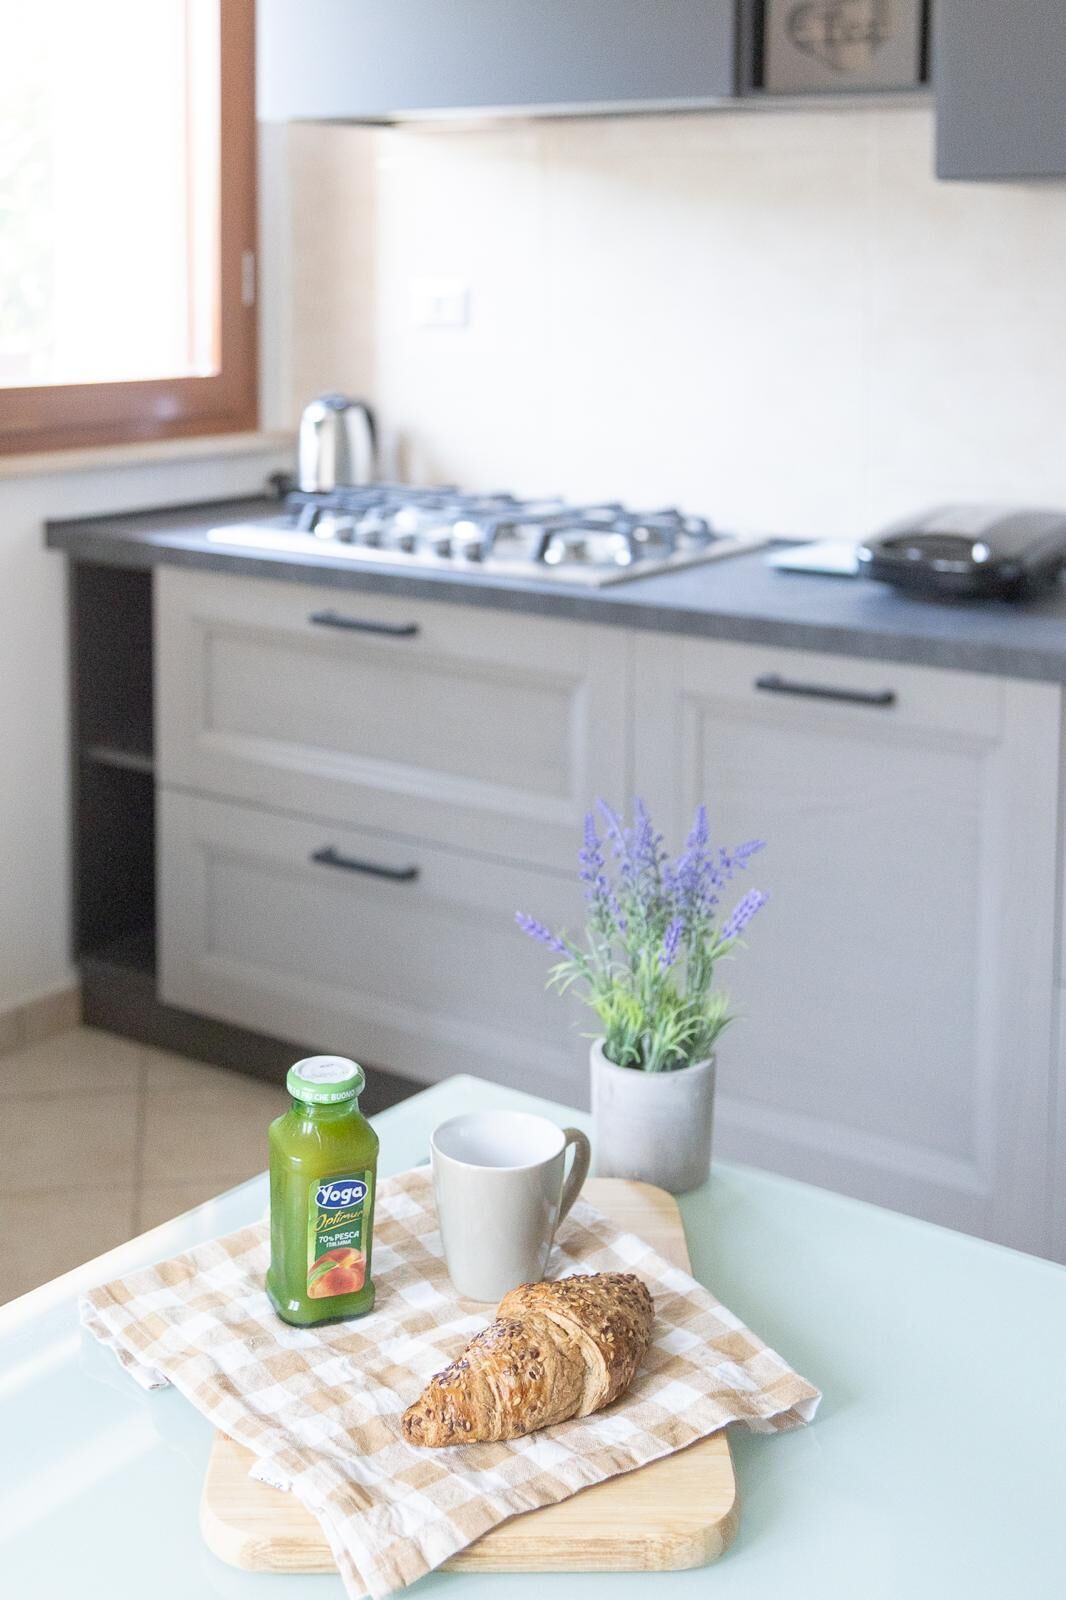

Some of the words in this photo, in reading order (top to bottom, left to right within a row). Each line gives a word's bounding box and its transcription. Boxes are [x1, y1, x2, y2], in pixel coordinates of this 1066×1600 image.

[331, 1089, 355, 1101] BUONO
[320, 1185, 363, 1204] Yoga
[335, 1230, 359, 1240] PESCA
